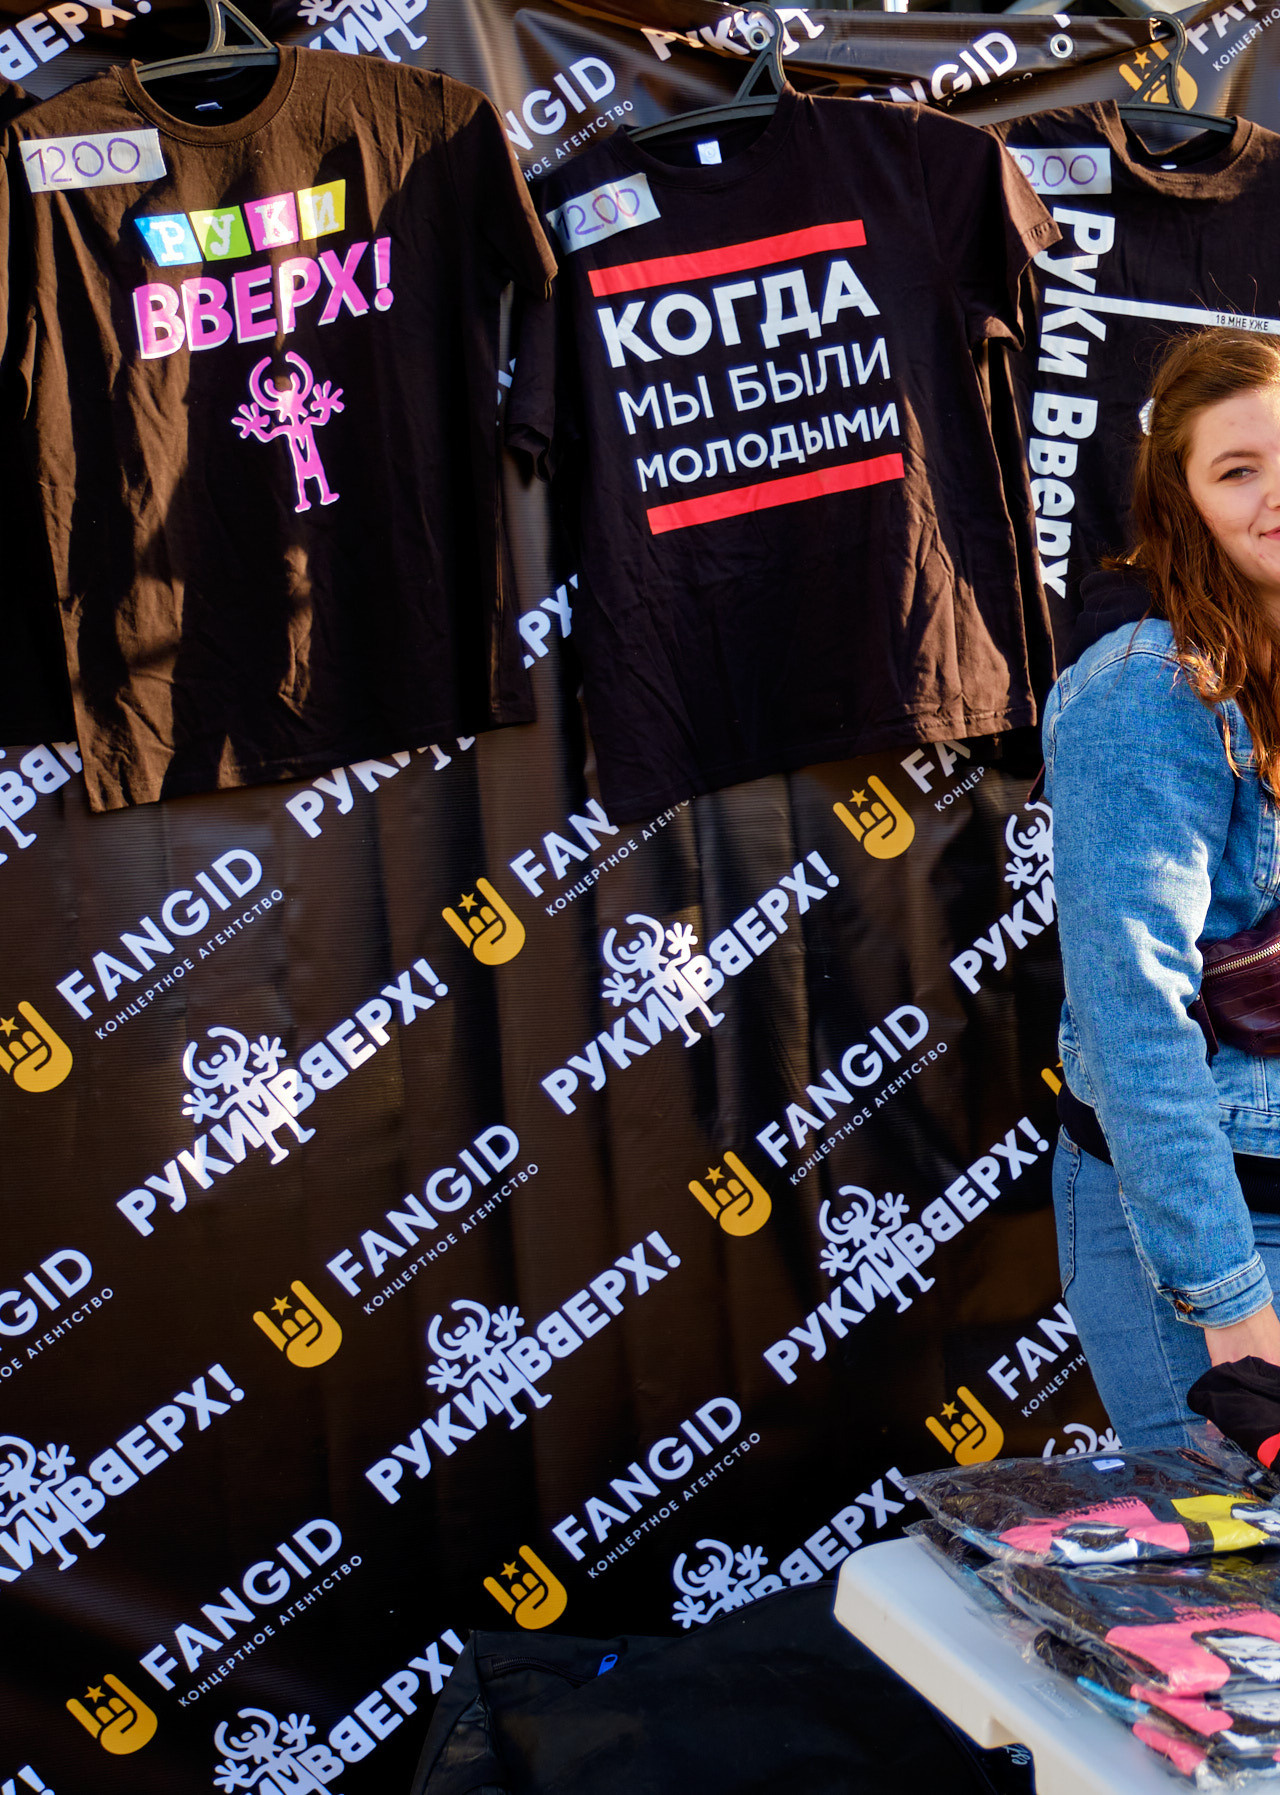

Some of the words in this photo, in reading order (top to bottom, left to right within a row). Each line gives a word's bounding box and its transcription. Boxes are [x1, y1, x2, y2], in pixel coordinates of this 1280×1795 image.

[26, 137, 140, 185] 1200
[555, 100, 635, 159] АГЕНТСТВО
[1012, 154, 1098, 187] 200
[150, 190, 340, 263] РУКИ
[558, 188, 640, 240] 1200
[134, 237, 394, 360] ВВЕРХ!
[597, 260, 881, 369] КОГДА
[1216, 314, 1226, 325] 18
[1227, 316, 1247, 328] МНЕ
[1249, 319, 1269, 331] УЖЕ
[619, 376, 714, 435] МЫ
[728, 338, 891, 412] БЫЛИ
[636, 403, 900, 493] МОЛОДЫМИ
[56, 849, 263, 1021] FANGID
[545, 839, 639, 917] КОНЦЕРТНОЕ
[95, 958, 195, 1041] КОНЦЕРТНОЕ
[198, 888, 283, 960] АГЕНТСТВО
[756, 1004, 930, 1168] FANGID
[789, 1107, 873, 1187] КОНЦЕРТНОЕ
[873, 1041, 948, 1109] АГЕНТСТВО
[326, 1124, 520, 1297] FANGID
[363, 1233, 458, 1315] КОНЦЕРТНОЕ
[461, 1162, 540, 1235] АГЕНТСТВО
[26, 1287, 114, 1360] АГЕНТСТВО
[552, 1397, 743, 1561] FANGID
[587, 1500, 680, 1580] КОНЦЕРТНОЕ
[681, 1430, 762, 1502] АГЕНТСТВО
[139, 1518, 342, 1692] FANGID
[177, 1625, 276, 1709] КОНЦЕРТНОЕ
[279, 1554, 363, 1627] АГЕНТСТВО
